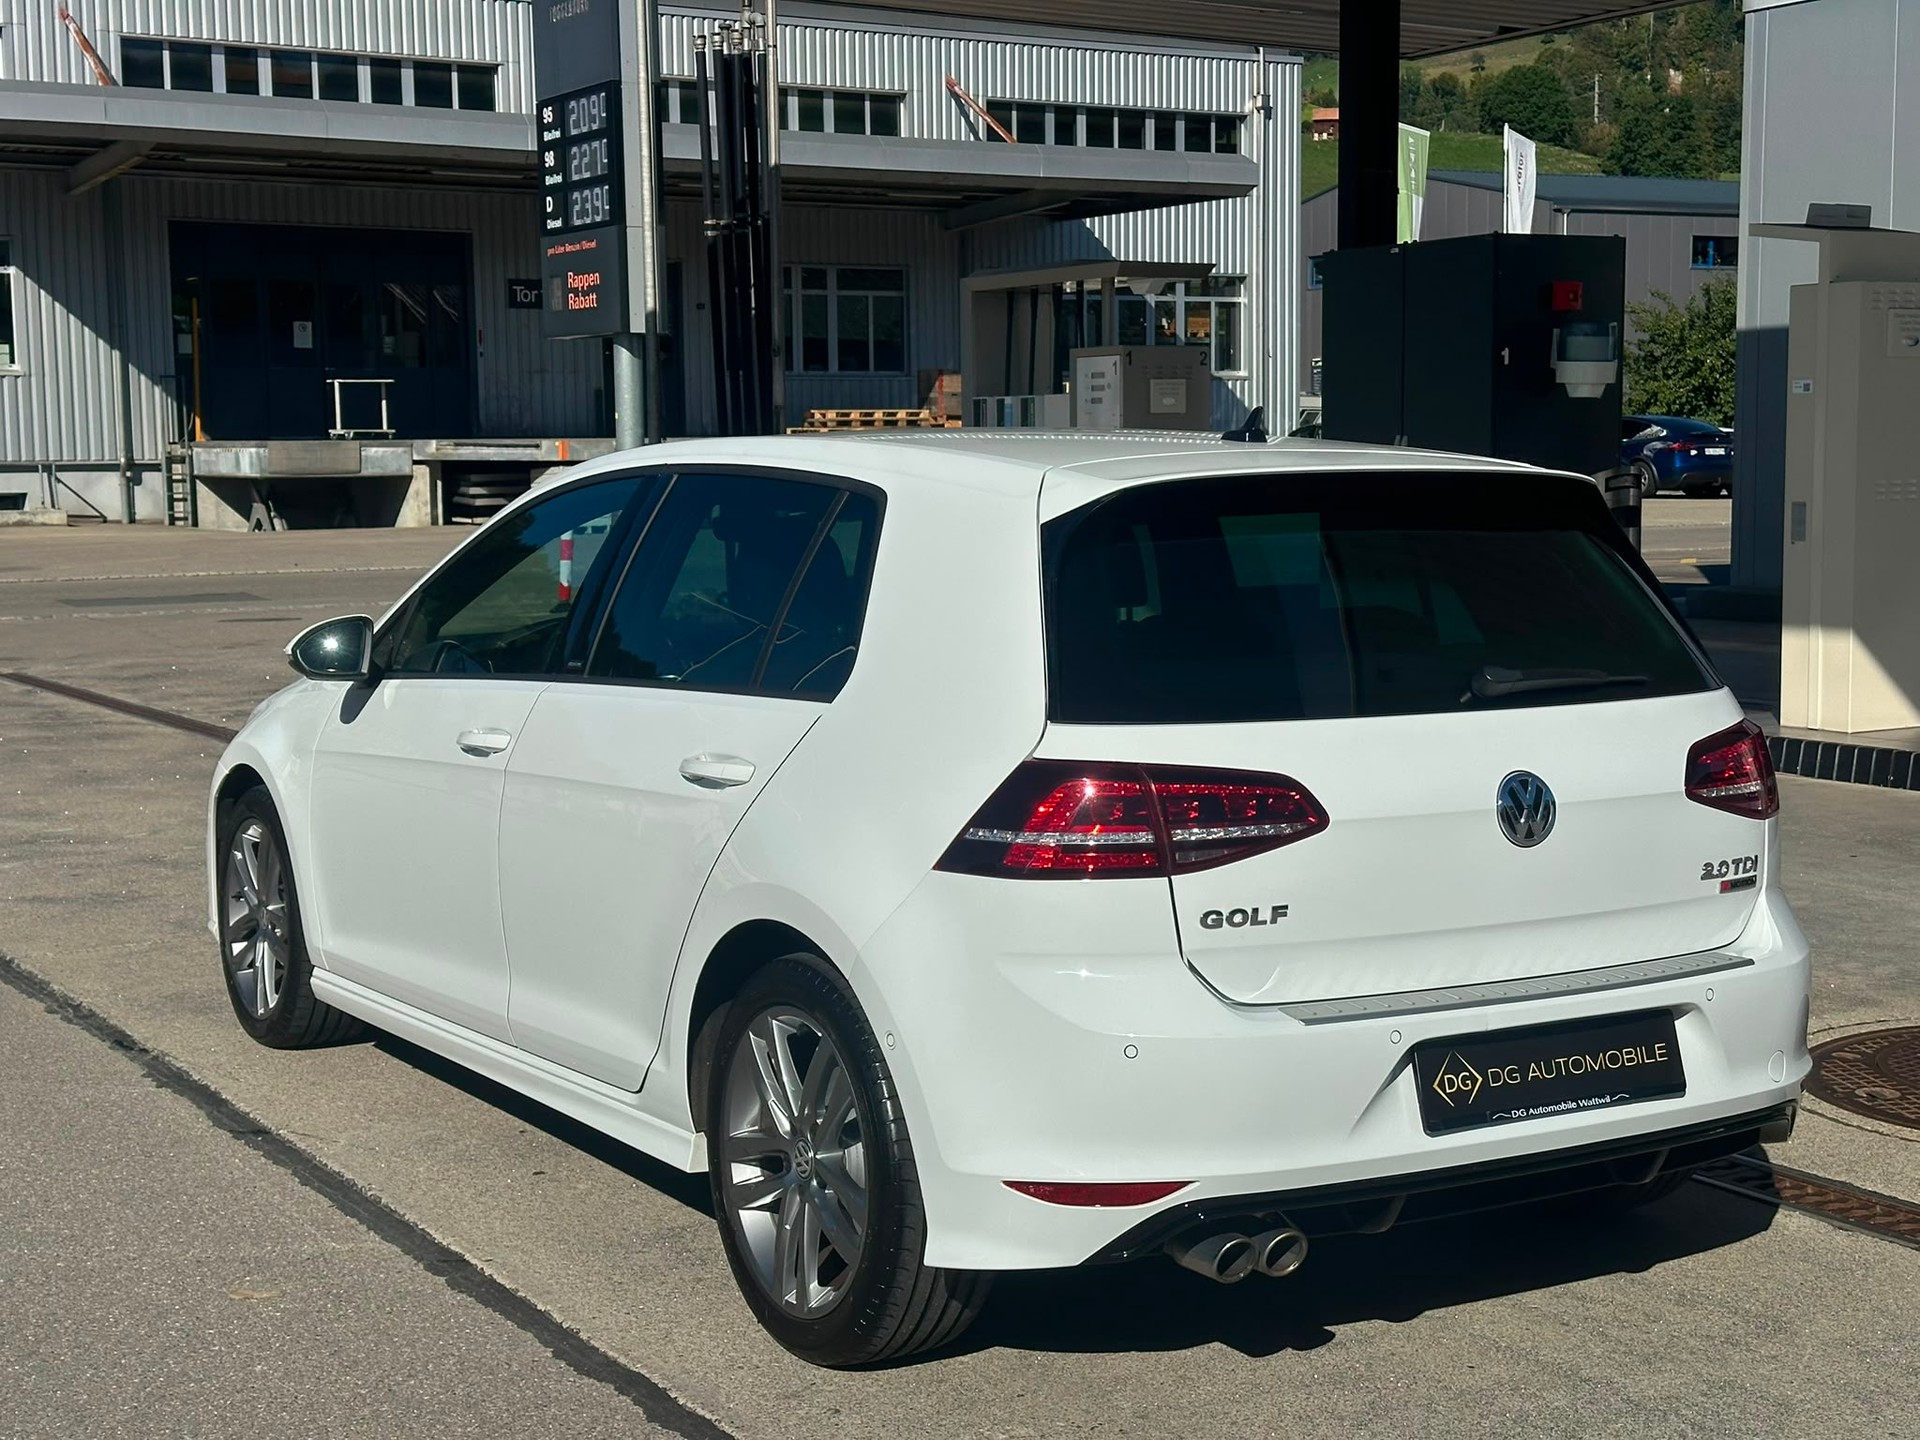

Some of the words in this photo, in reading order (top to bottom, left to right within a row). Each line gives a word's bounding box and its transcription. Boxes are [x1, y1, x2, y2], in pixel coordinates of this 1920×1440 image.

[542, 106, 554, 124] 95
[544, 150, 555, 168] 98
[545, 196, 554, 213] D
[546, 217, 562, 230] Diesel
[567, 271, 600, 291] Rappen
[512, 285, 539, 303] Tor
[568, 292, 598, 311] Rabatt
[1125, 351, 1133, 366] 1
[1199, 351, 1208, 366] 2
[1501, 347, 1509, 365] 1
[1111, 360, 1118, 376] 1
[1700, 859, 1730, 881] 2.0
[1731, 854, 1759, 876] TDI
[1199, 904, 1289, 930] GOLF
[1487, 1065, 1521, 1087] DG
[1527, 1042, 1669, 1082] AUTOMOBILE
[1443, 1071, 1472, 1094] DG
[1511, 1108, 1527, 1119] DG
[1528, 1099, 1578, 1116] Automobile
